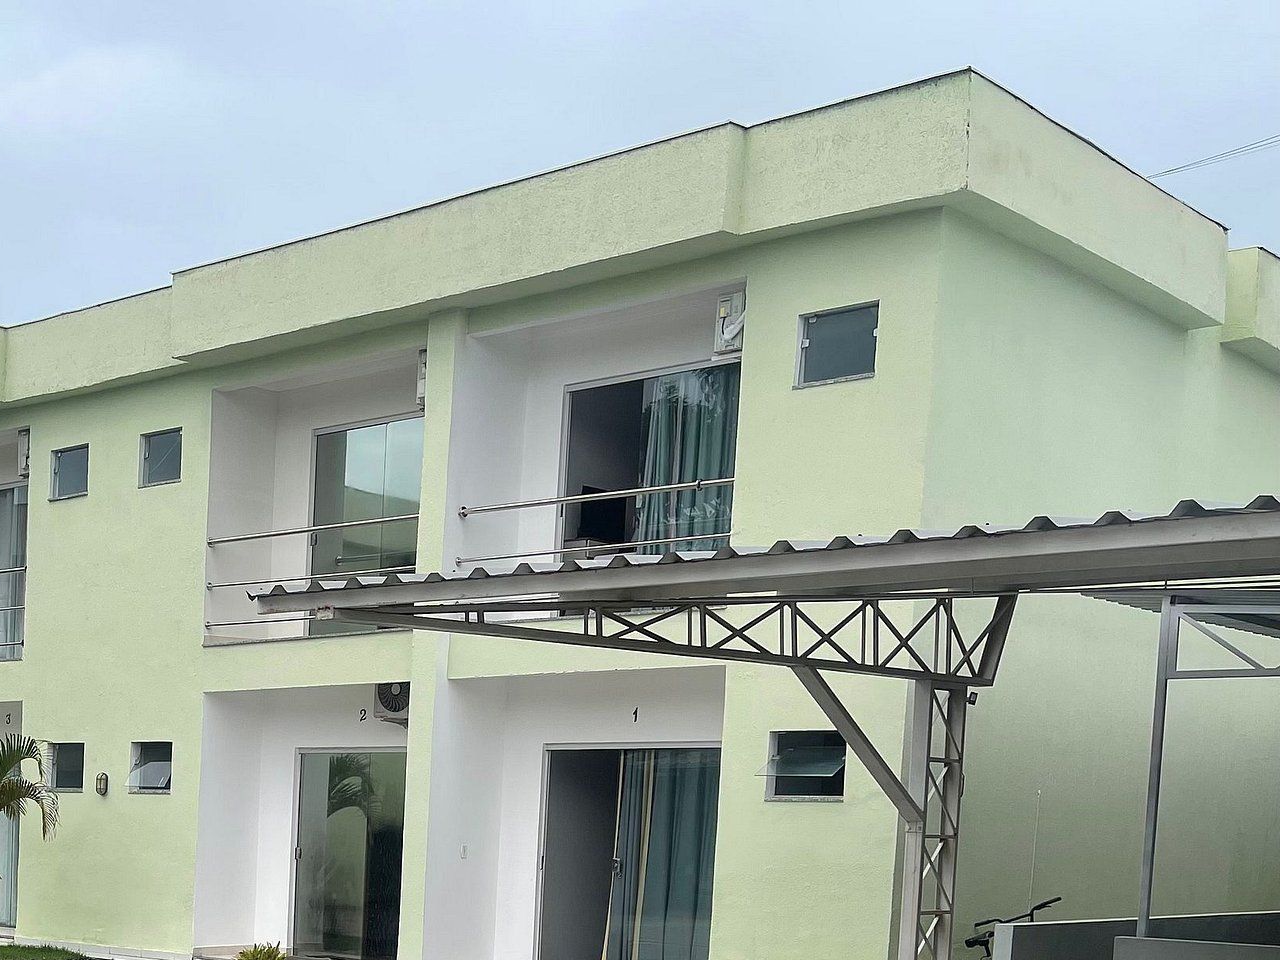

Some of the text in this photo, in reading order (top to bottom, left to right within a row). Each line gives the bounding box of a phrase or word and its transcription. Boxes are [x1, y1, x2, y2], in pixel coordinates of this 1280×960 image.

[5, 713, 11, 725] 3
[359, 708, 367, 722] 2
[632, 706, 639, 723] 1
